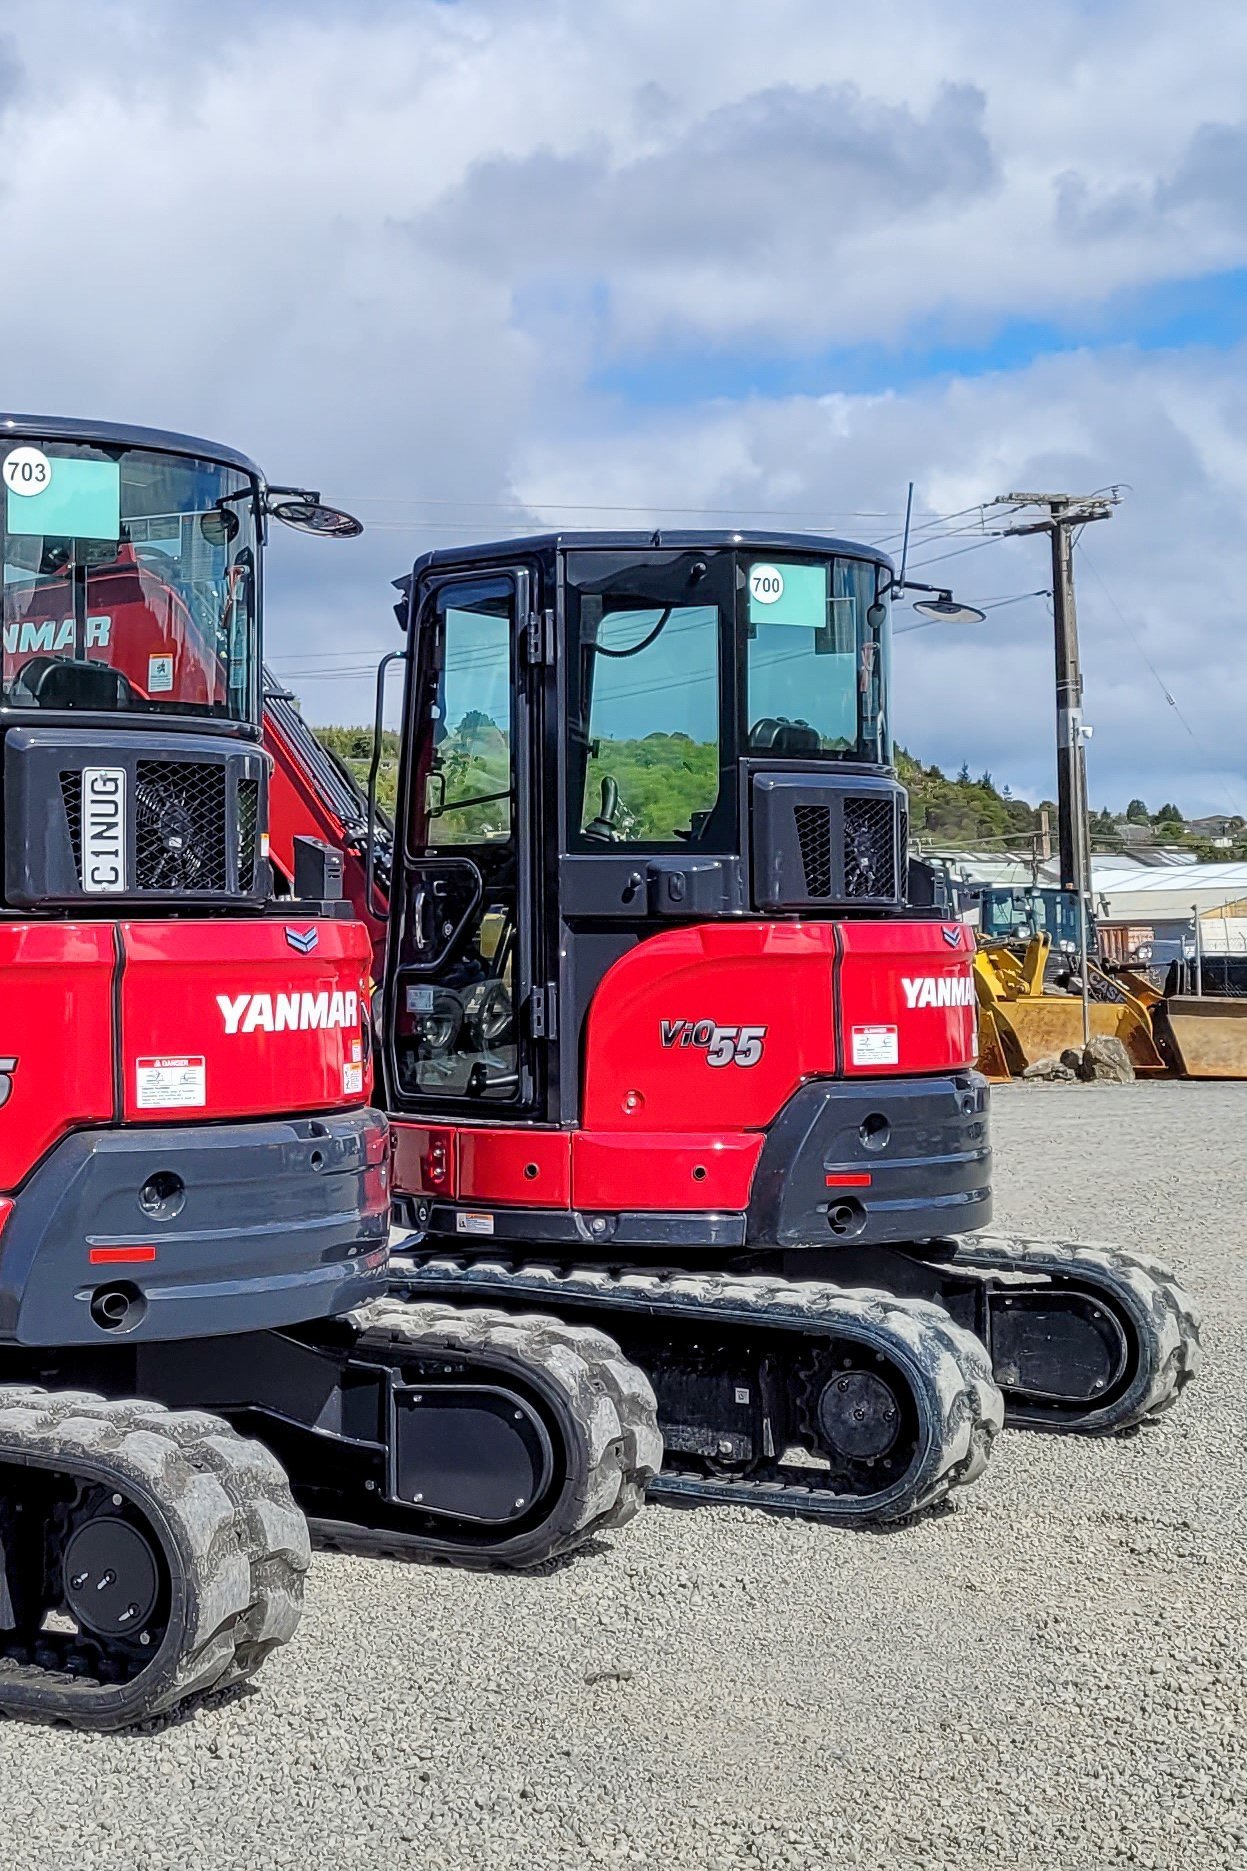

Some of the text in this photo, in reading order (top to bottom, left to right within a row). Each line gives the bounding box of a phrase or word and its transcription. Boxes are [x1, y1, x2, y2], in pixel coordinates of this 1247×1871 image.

[7, 462, 47, 482] 703
[753, 577, 780, 593] 700
[215, 991, 358, 1034] YANMAR
